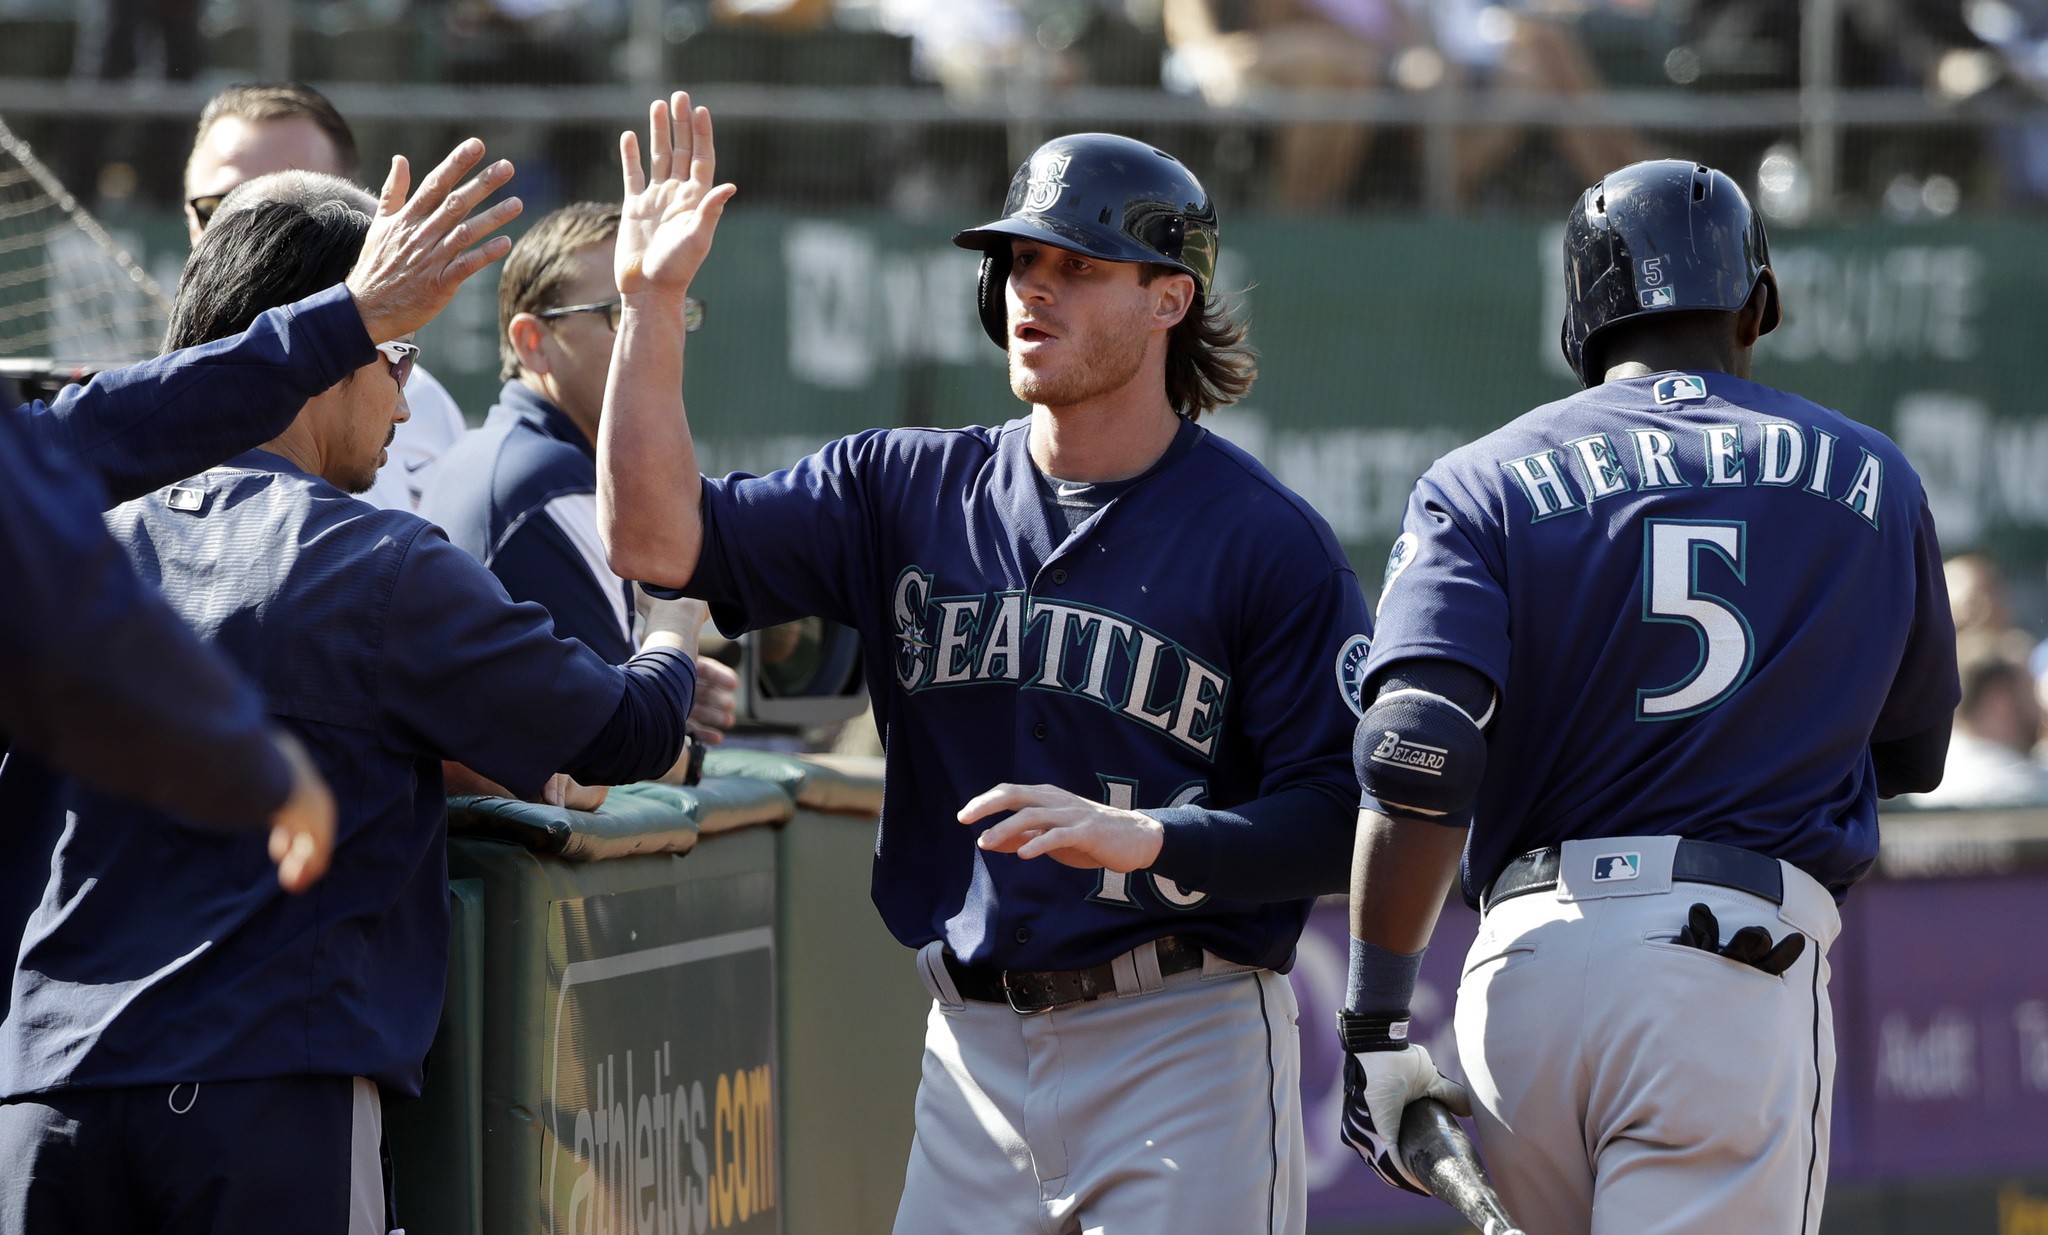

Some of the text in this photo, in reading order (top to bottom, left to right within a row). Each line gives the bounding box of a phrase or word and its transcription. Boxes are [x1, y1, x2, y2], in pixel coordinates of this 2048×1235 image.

[1643, 258, 1663, 286] 5
[1502, 420, 1883, 531] HEREDIA
[893, 565, 1231, 763] SEATTLE
[1345, 644, 1370, 673] SEAT
[1635, 517, 1756, 722] 5
[1373, 731, 1446, 770] BELGARD
[568, 1041, 775, 1235] athletics.com
